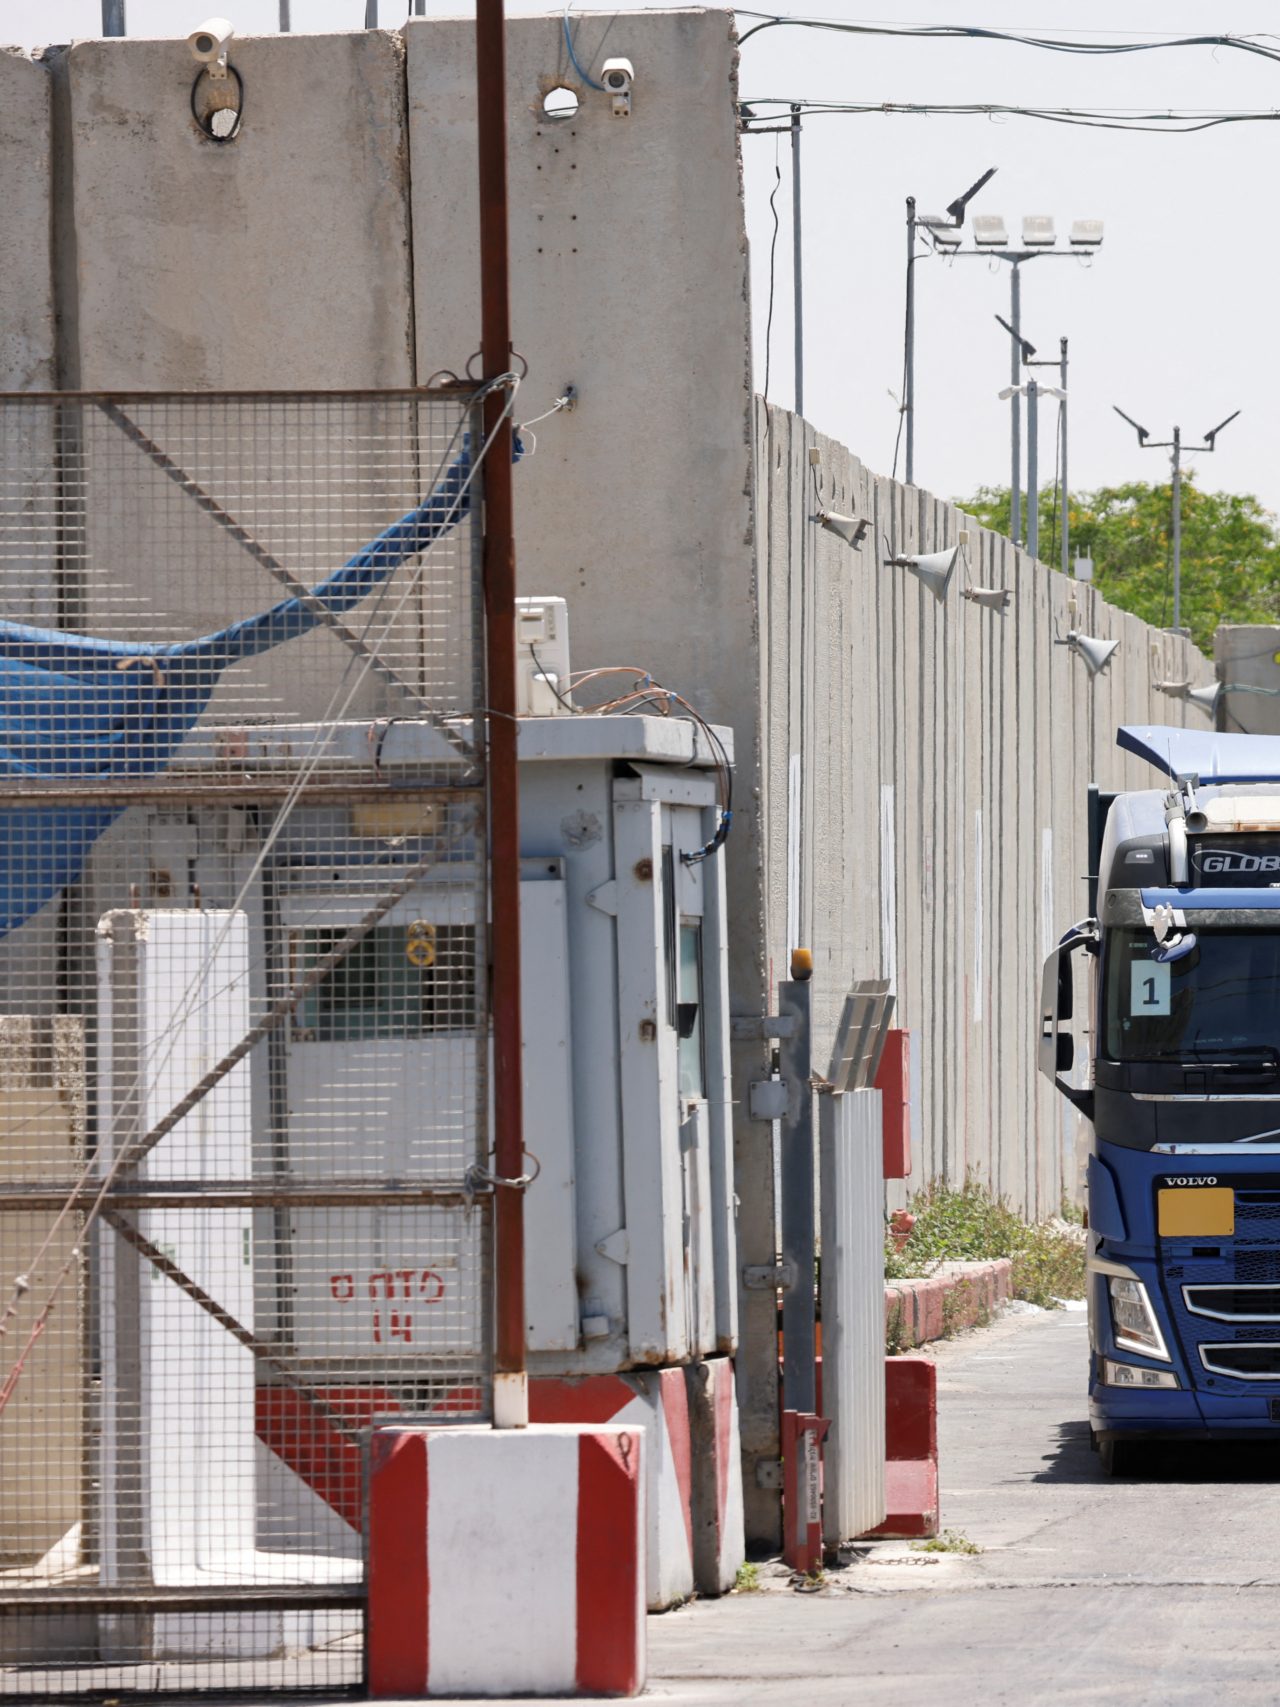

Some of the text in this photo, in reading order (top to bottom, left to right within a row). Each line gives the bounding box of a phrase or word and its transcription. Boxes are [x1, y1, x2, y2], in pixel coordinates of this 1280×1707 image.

[1142, 976, 1160, 1006] 1
[1164, 1176, 1218, 1186] VOLVO
[373, 1308, 413, 1344] 14
